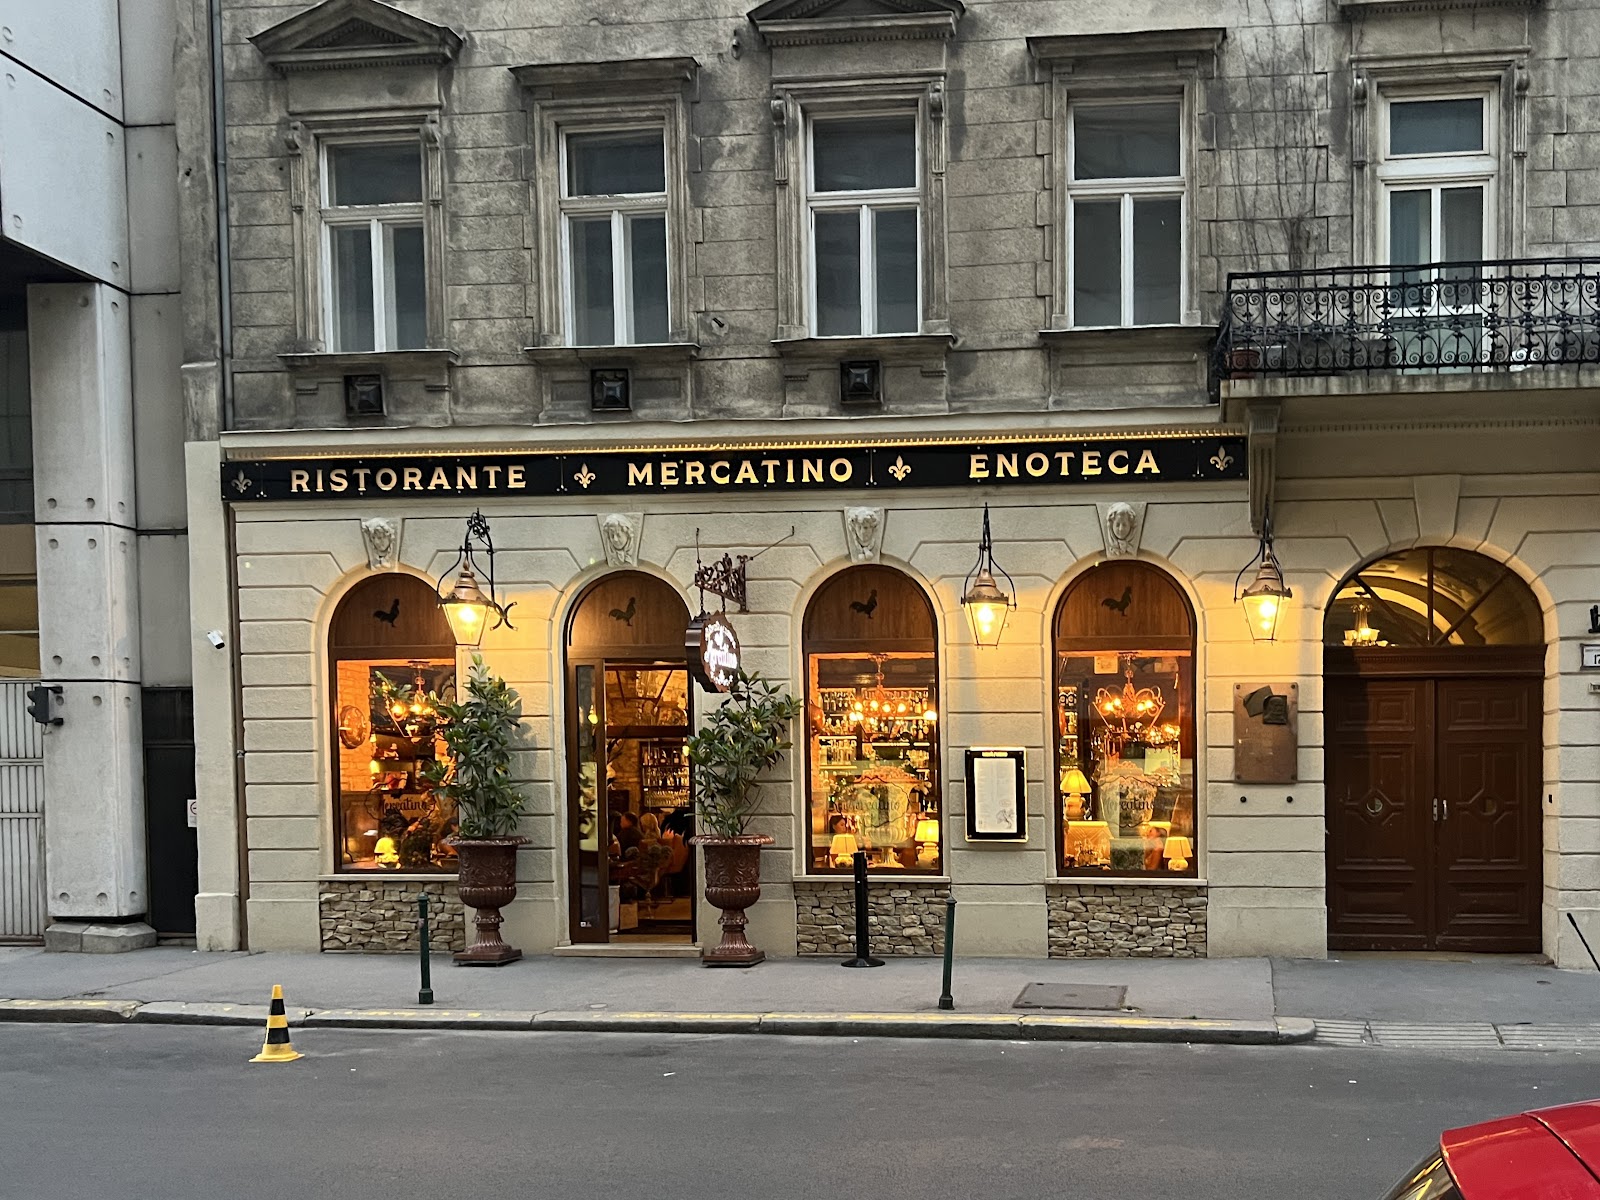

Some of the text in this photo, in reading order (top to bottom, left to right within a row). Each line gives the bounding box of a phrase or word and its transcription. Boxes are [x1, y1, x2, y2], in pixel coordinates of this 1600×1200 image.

[290, 464, 528, 493] RISTORANTE
[627, 457, 854, 487] MERCATINO
[968, 449, 1162, 479] ENOTECA
